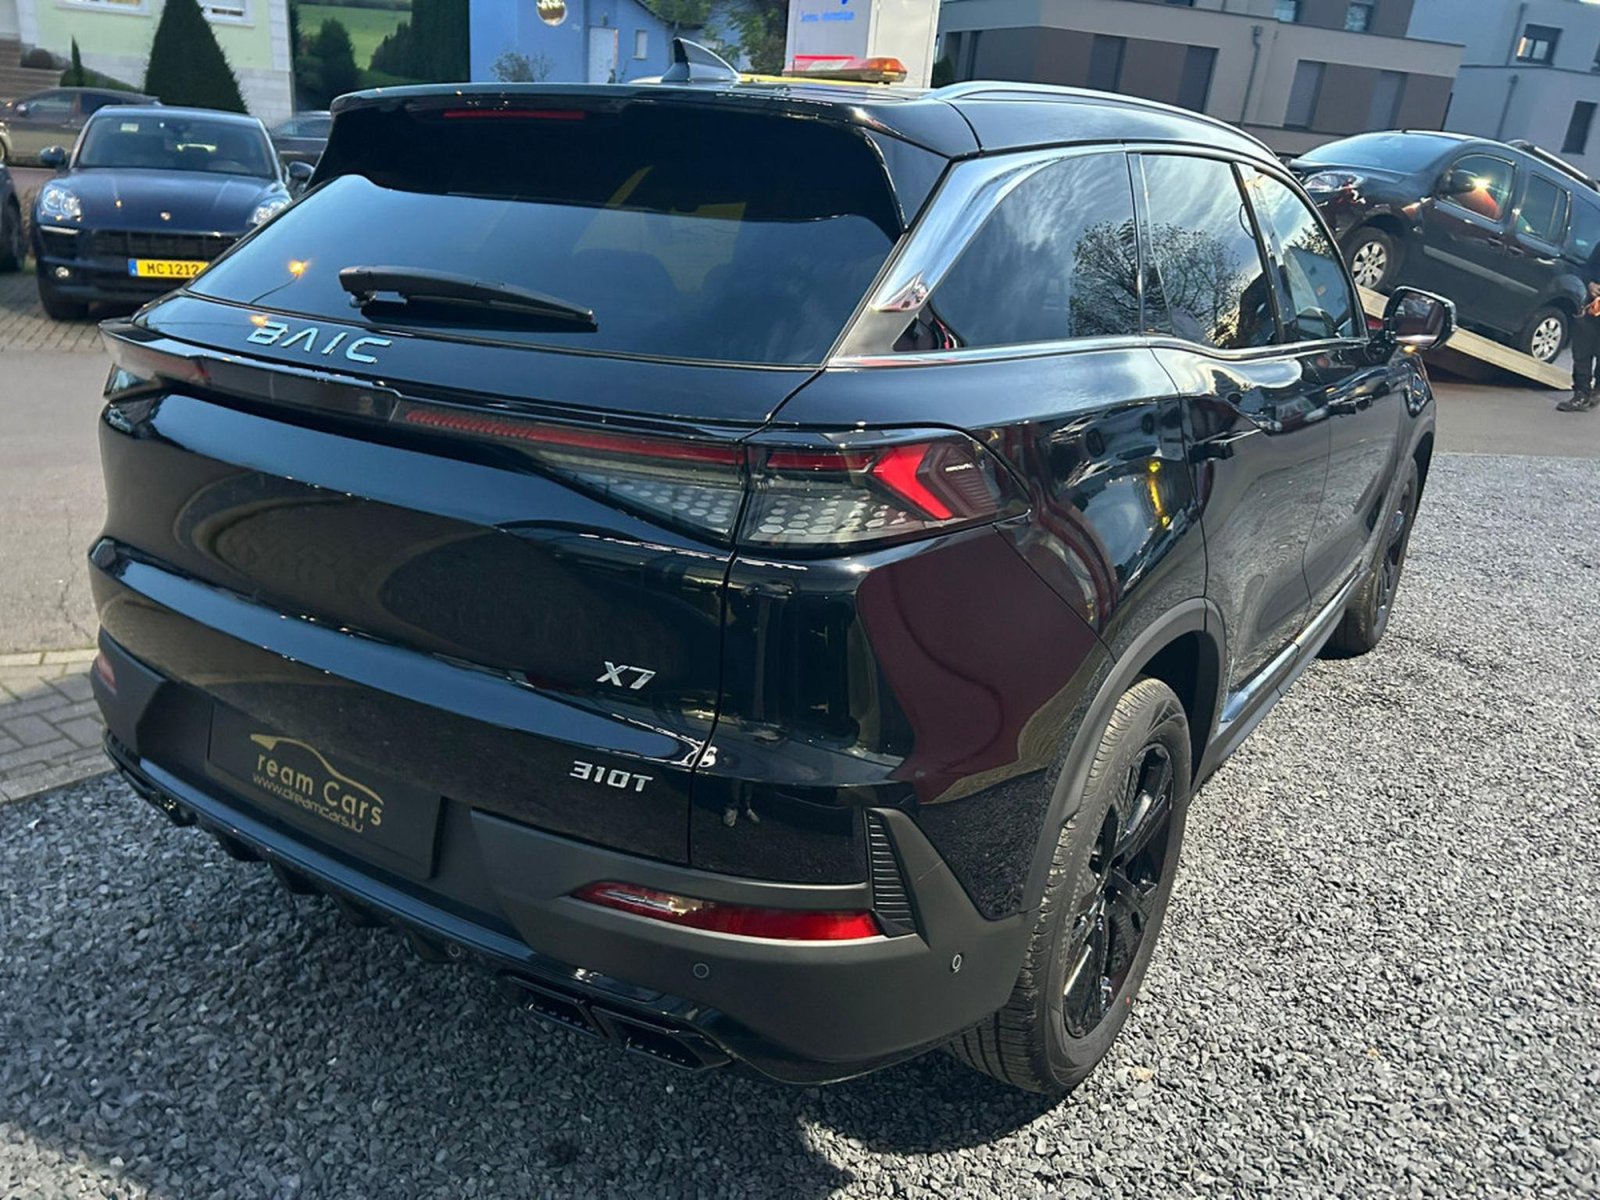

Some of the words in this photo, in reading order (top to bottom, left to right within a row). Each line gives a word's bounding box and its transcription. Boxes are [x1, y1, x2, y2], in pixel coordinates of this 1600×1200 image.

[246, 319, 393, 364] BAIC
[596, 660, 657, 690] X7
[569, 760, 654, 792] 310T
[323, 780, 383, 826] Cars
